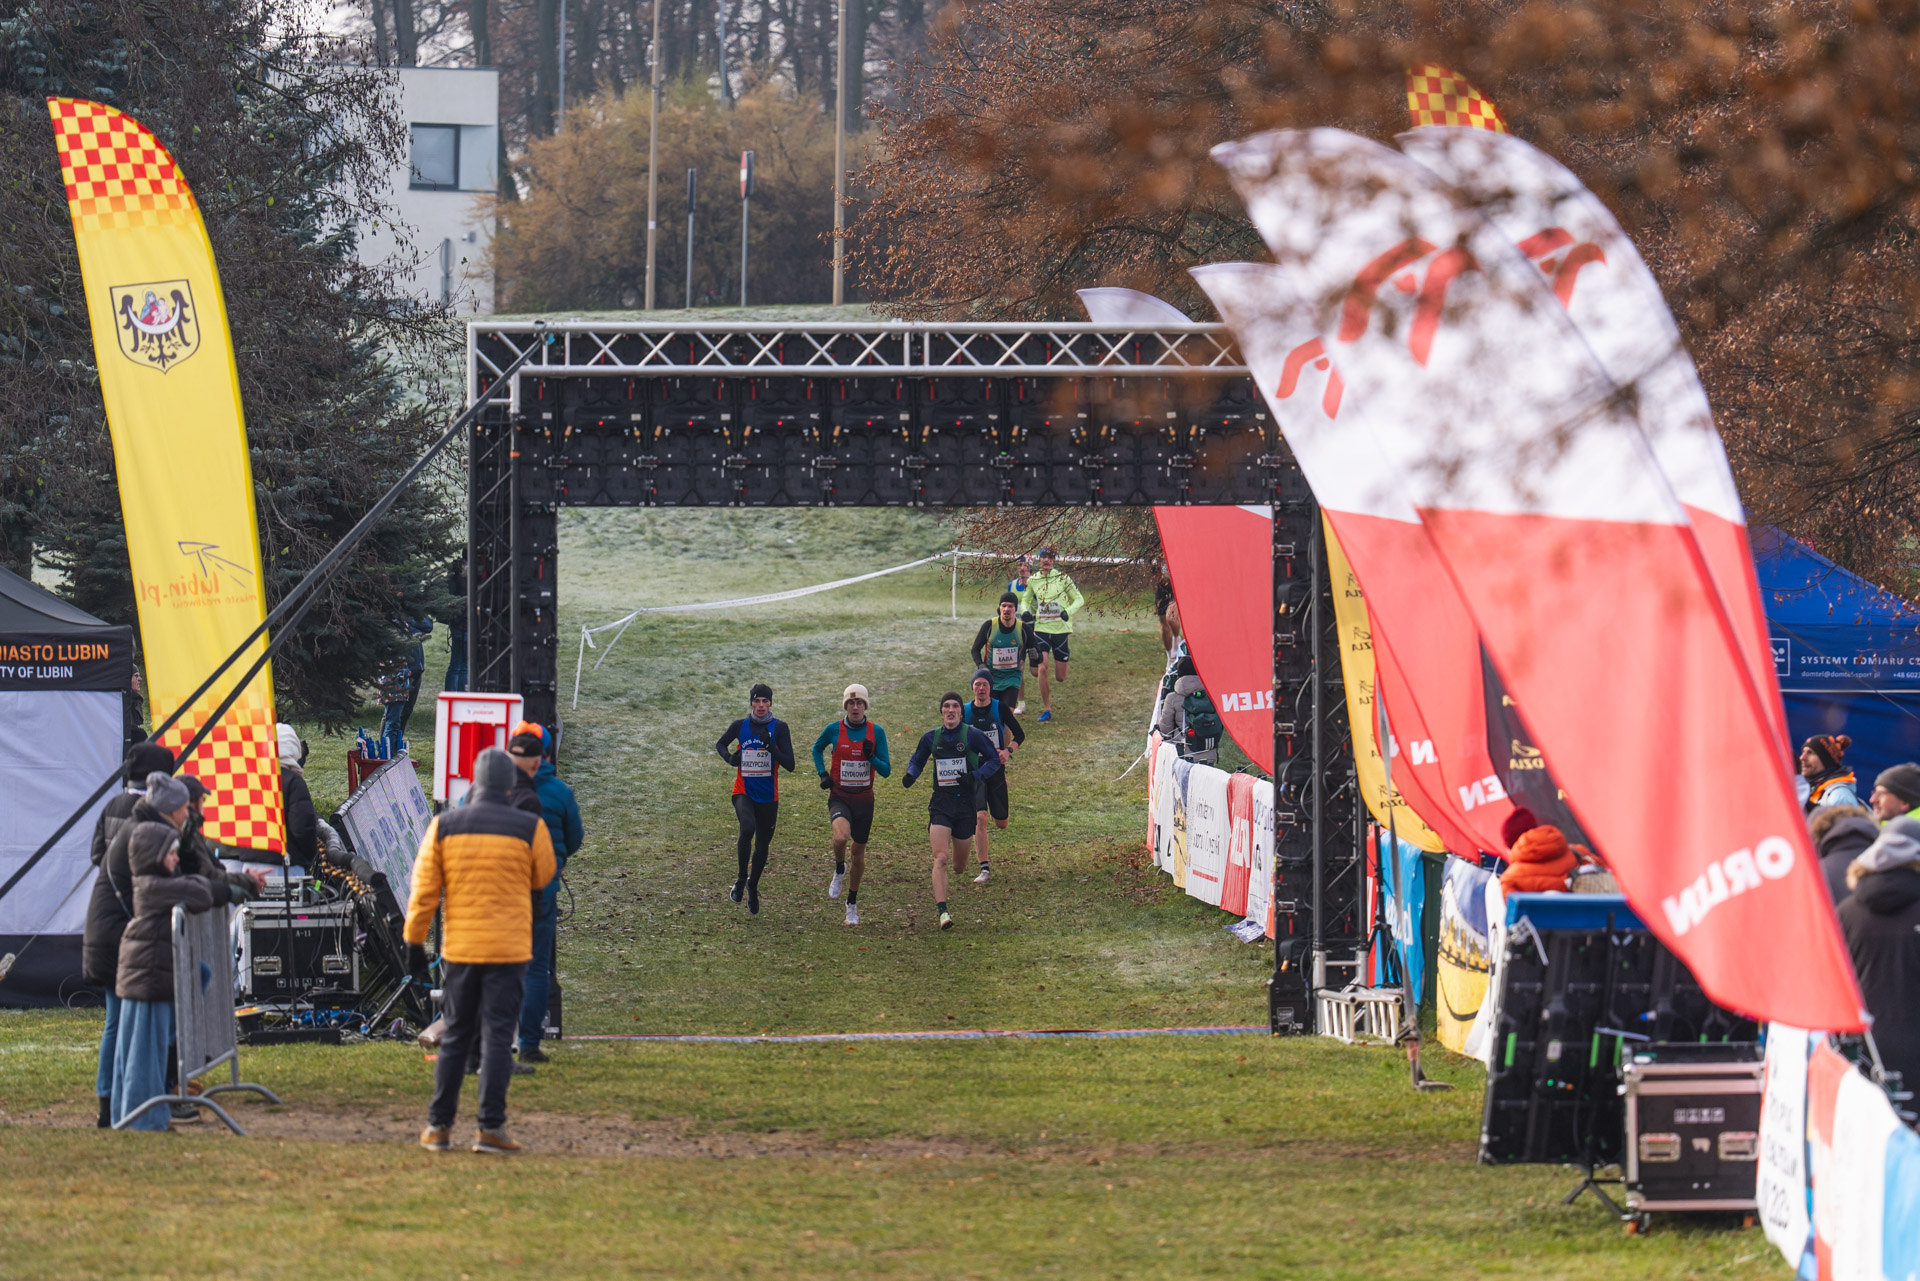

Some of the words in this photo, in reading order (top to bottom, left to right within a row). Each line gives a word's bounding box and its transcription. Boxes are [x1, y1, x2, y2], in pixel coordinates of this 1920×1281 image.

[58, 644, 109, 660] LUBIN
[1800, 656, 1848, 665] SYSTEMY
[18, 667, 34, 678] OF
[37, 666, 73, 678] LUBIN
